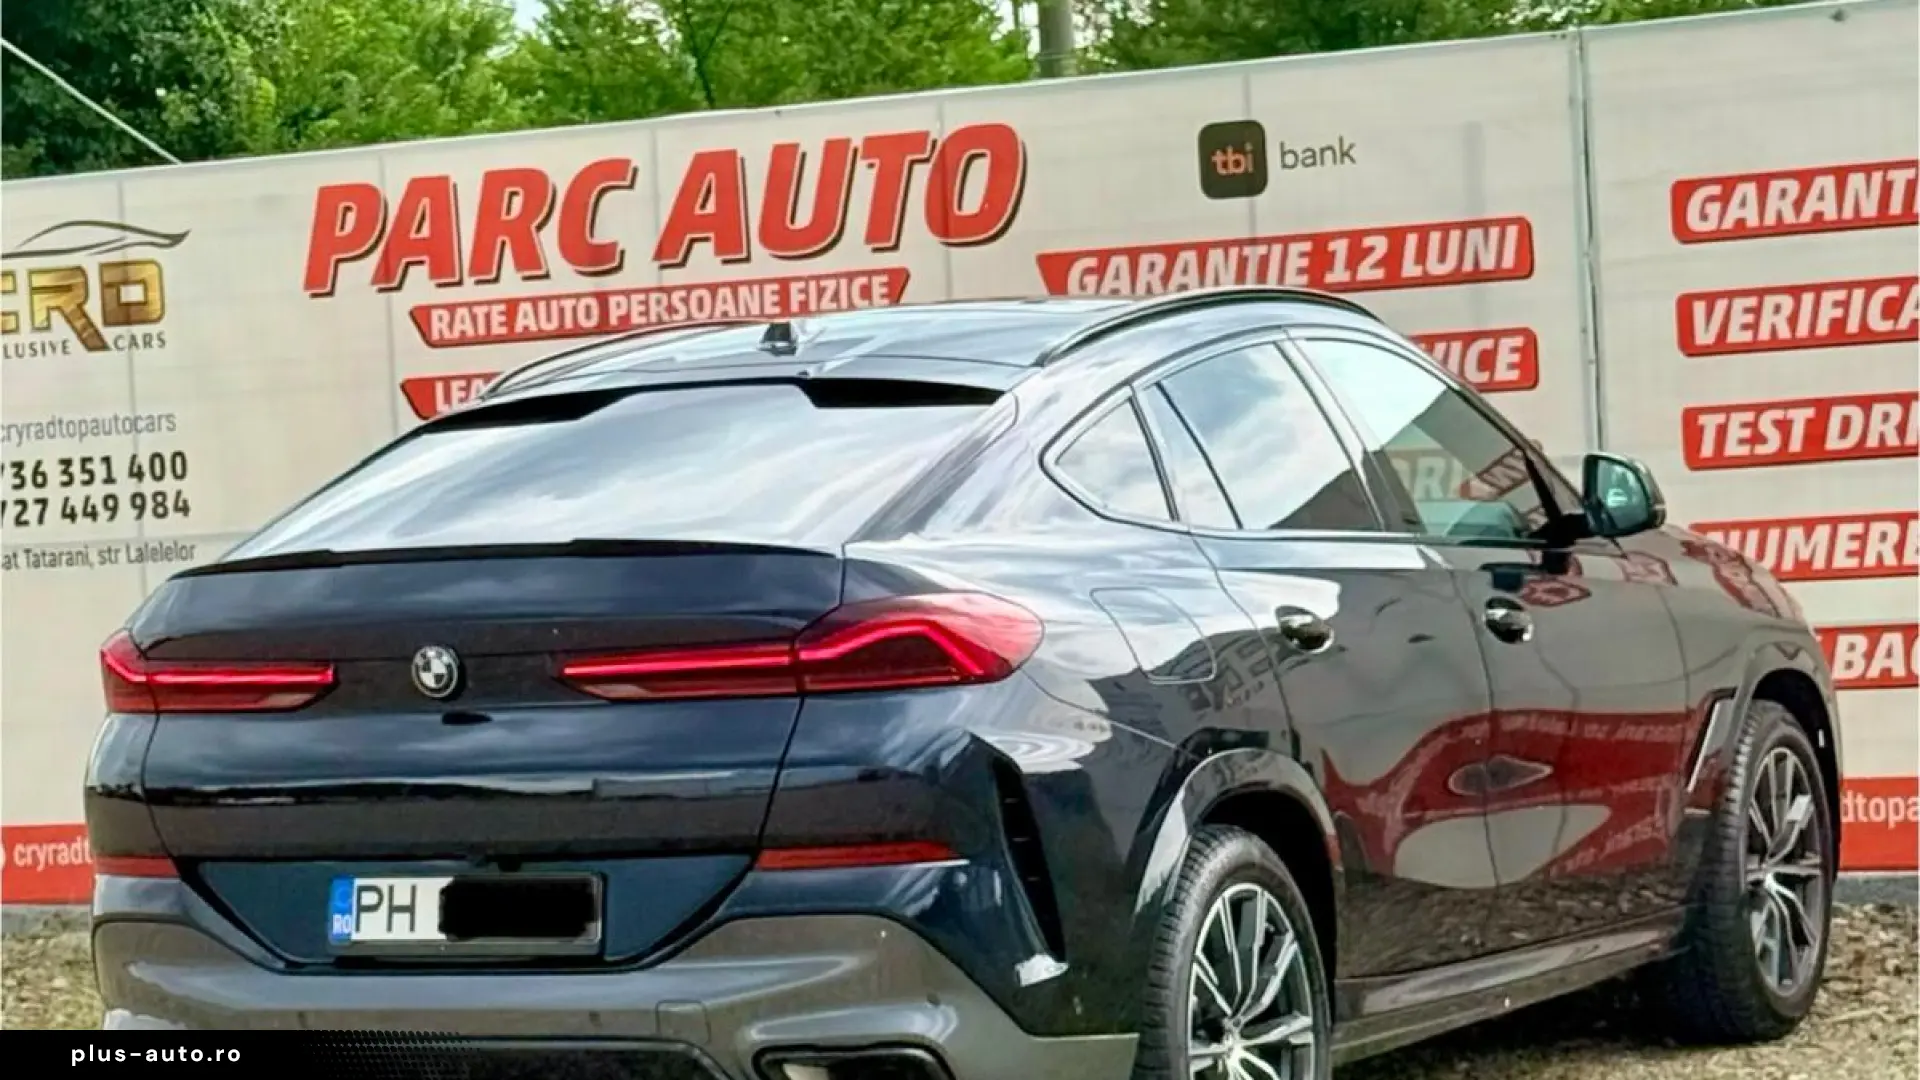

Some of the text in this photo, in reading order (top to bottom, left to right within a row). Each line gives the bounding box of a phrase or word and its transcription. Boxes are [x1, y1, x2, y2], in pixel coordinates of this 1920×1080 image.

[1211, 136, 1357, 177] tbi bank
[302, 122, 1027, 298] PARC AUTO
[1067, 224, 1518, 297] GARANTIE 12 LUNI
[430, 273, 891, 341] RATE AUTO PERSOANE FIZICE
[112, 331, 167, 352] CARS
[1697, 406, 1816, 459] TEST
[0, 450, 189, 491] 36 351 400
[60, 492, 119, 524] 449
[130, 489, 191, 521] 984
[23, 544, 94, 570] Tatarani,
[97, 546, 121, 567] str
[126, 540, 196, 564] Lalelelor
[1831, 630, 1918, 681] BA
[355, 884, 417, 933] PH
